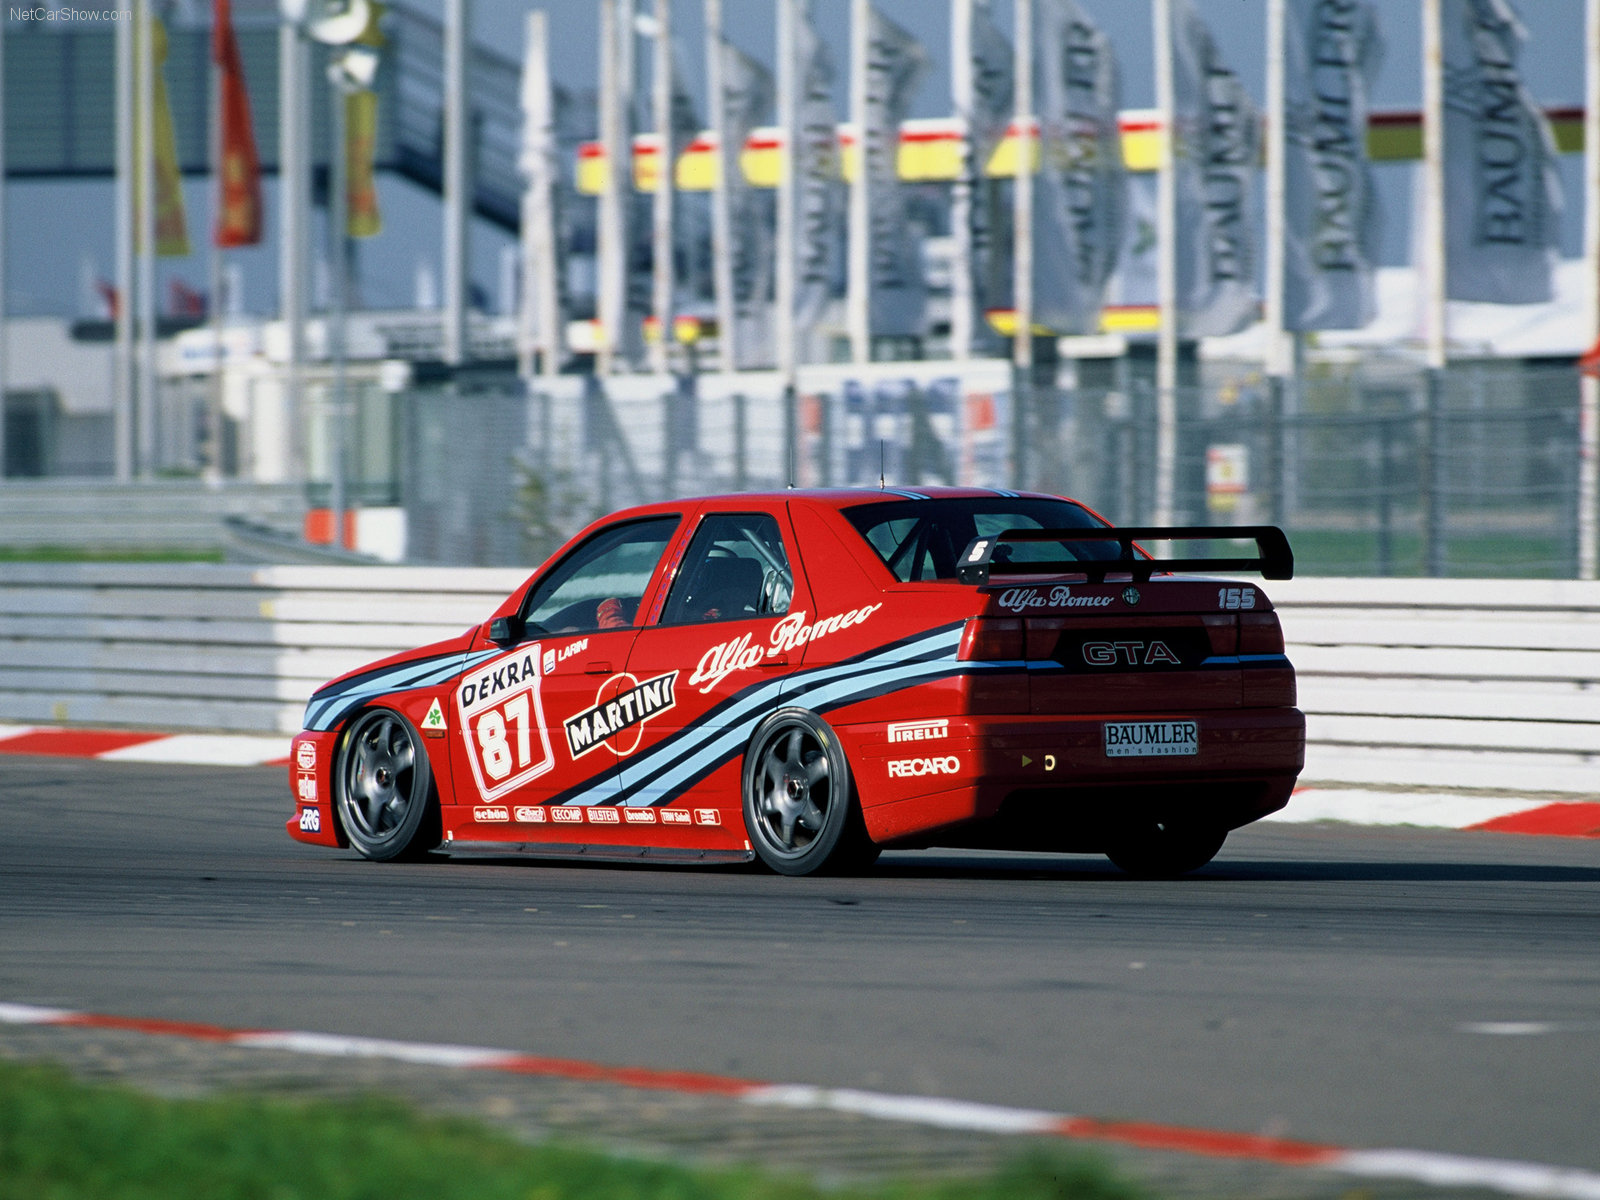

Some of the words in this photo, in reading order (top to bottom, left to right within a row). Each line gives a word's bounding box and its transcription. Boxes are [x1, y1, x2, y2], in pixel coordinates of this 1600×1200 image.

[998, 588, 1047, 612] Alfa
[1047, 585, 1114, 607] Romeo
[1218, 588, 1256, 609] 155
[557, 638, 589, 662] LARINI
[688, 632, 764, 694] Alfa
[767, 602, 883, 658] Romeo
[1082, 641, 1181, 665] GTA
[461, 654, 536, 709] DEKRA
[568, 676, 673, 751] MARTINI
[476, 692, 532, 781] 87
[887, 719, 949, 743] PIRELLI
[1106, 724, 1196, 745] BÄUMLER
[1107, 746, 1143, 755] men's
[1151, 746, 1197, 754] fashion
[888, 756, 960, 778] RECARO
[299, 808, 320, 832] ERG
[475, 808, 507, 820] schön
[552, 809, 581, 821] CECOMP
[588, 809, 619, 821] BILSTEIN
